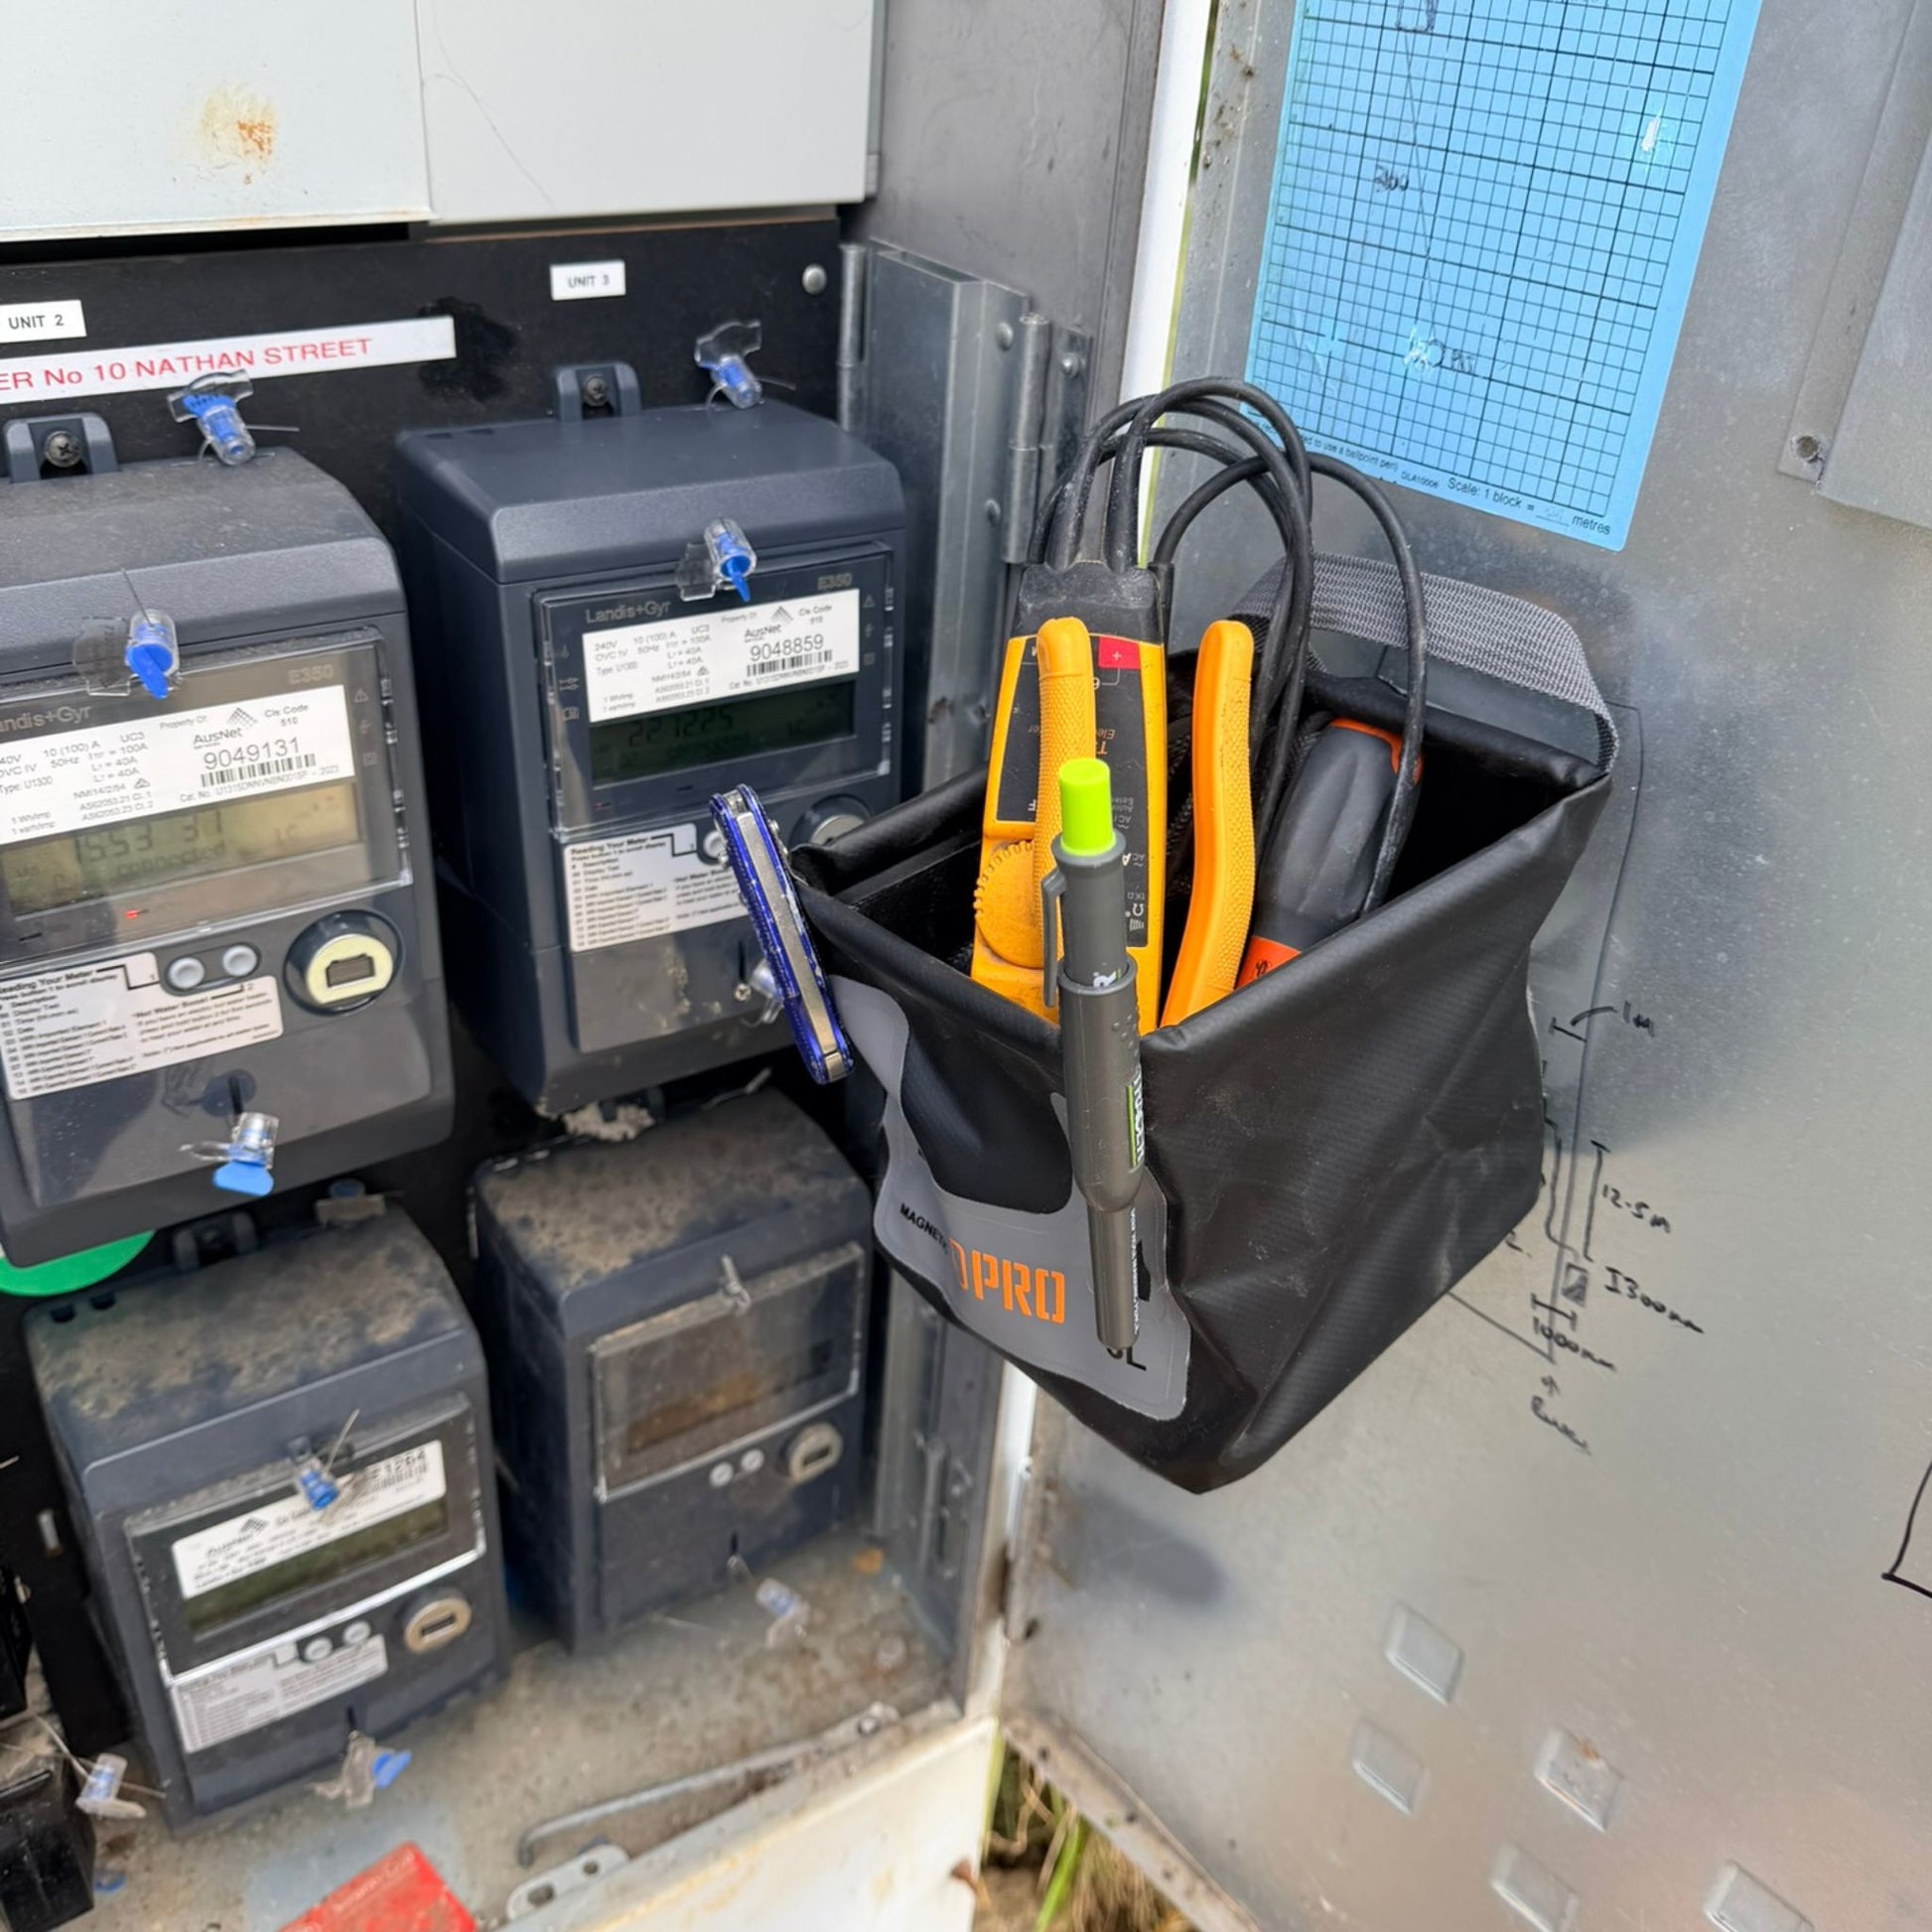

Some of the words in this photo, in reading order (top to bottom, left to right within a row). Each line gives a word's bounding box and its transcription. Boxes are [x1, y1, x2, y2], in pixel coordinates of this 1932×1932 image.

[567, 275, 597, 289] UNIT
[603, 274, 611, 286] 3
[8, 315, 46, 330] UNIT
[55, 314, 65, 327] 2
[44, 367, 83, 385] No
[94, 361, 126, 382] 10
[136, 350, 255, 378] NATHAN
[263, 339, 372, 364] STREET
[1448, 477, 1481, 496] Scale:
[1492, 491, 1522, 509] block
[1572, 513, 1611, 536] metres
[586, 599, 671, 623] Landis+Gyr
[750, 633, 825, 662] 9048859
[284, 703, 309, 716] Code
[194, 727, 244, 746] AusNet
[51, 756, 79, 769] 50Hz
[120, 743, 148, 756] 100A
[61, 742, 89, 757] (100)
[204, 737, 301, 771] 9049131
[39, 977, 62, 986] Your
[66, 971, 93, 981] Meter
